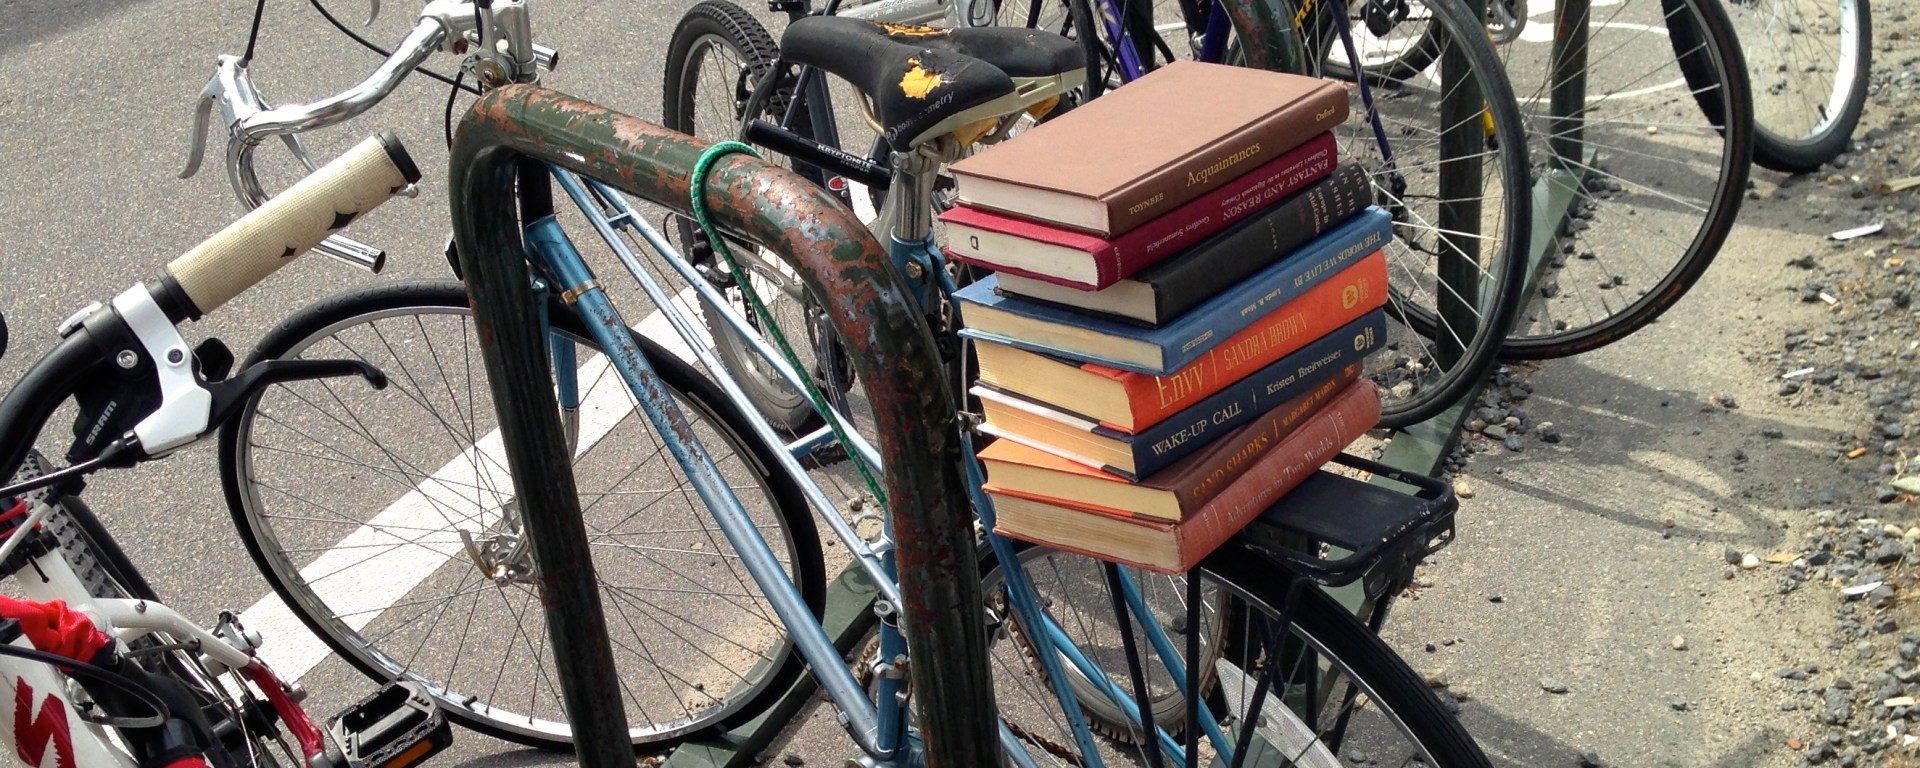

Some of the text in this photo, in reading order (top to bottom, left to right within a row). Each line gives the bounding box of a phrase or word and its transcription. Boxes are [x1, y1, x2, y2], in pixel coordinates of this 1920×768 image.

[1315, 106, 1335, 122] Oxford
[817, 145, 872, 170] KRYPTONITE
[1187, 142, 1261, 187] Acquaintances
[1350, 166, 1363, 191] FIRE
[1129, 192, 1164, 214] TOYNBEE
[1222, 159, 1328, 220] FANTASY AND REASON
[1315, 187, 1327, 213] Europe
[1327, 179, 1342, 216] ASHES
[1339, 172, 1356, 213] IN THE
[1292, 231, 1381, 288] THE WORDS WE LIVE BY
[1223, 333, 1268, 369] SANDRA
[1268, 312, 1308, 346] BROWN
[1155, 361, 1203, 409] Envy
[1266, 348, 1342, 395] Kristen Breitweiser
[86, 401, 117, 445] SRAM
[1152, 401, 1243, 456] WAKE-UP CALL
[1282, 397, 1313, 426] MARGARET
[1282, 461, 1305, 480] Two
[1303, 436, 1333, 462] Worlds
